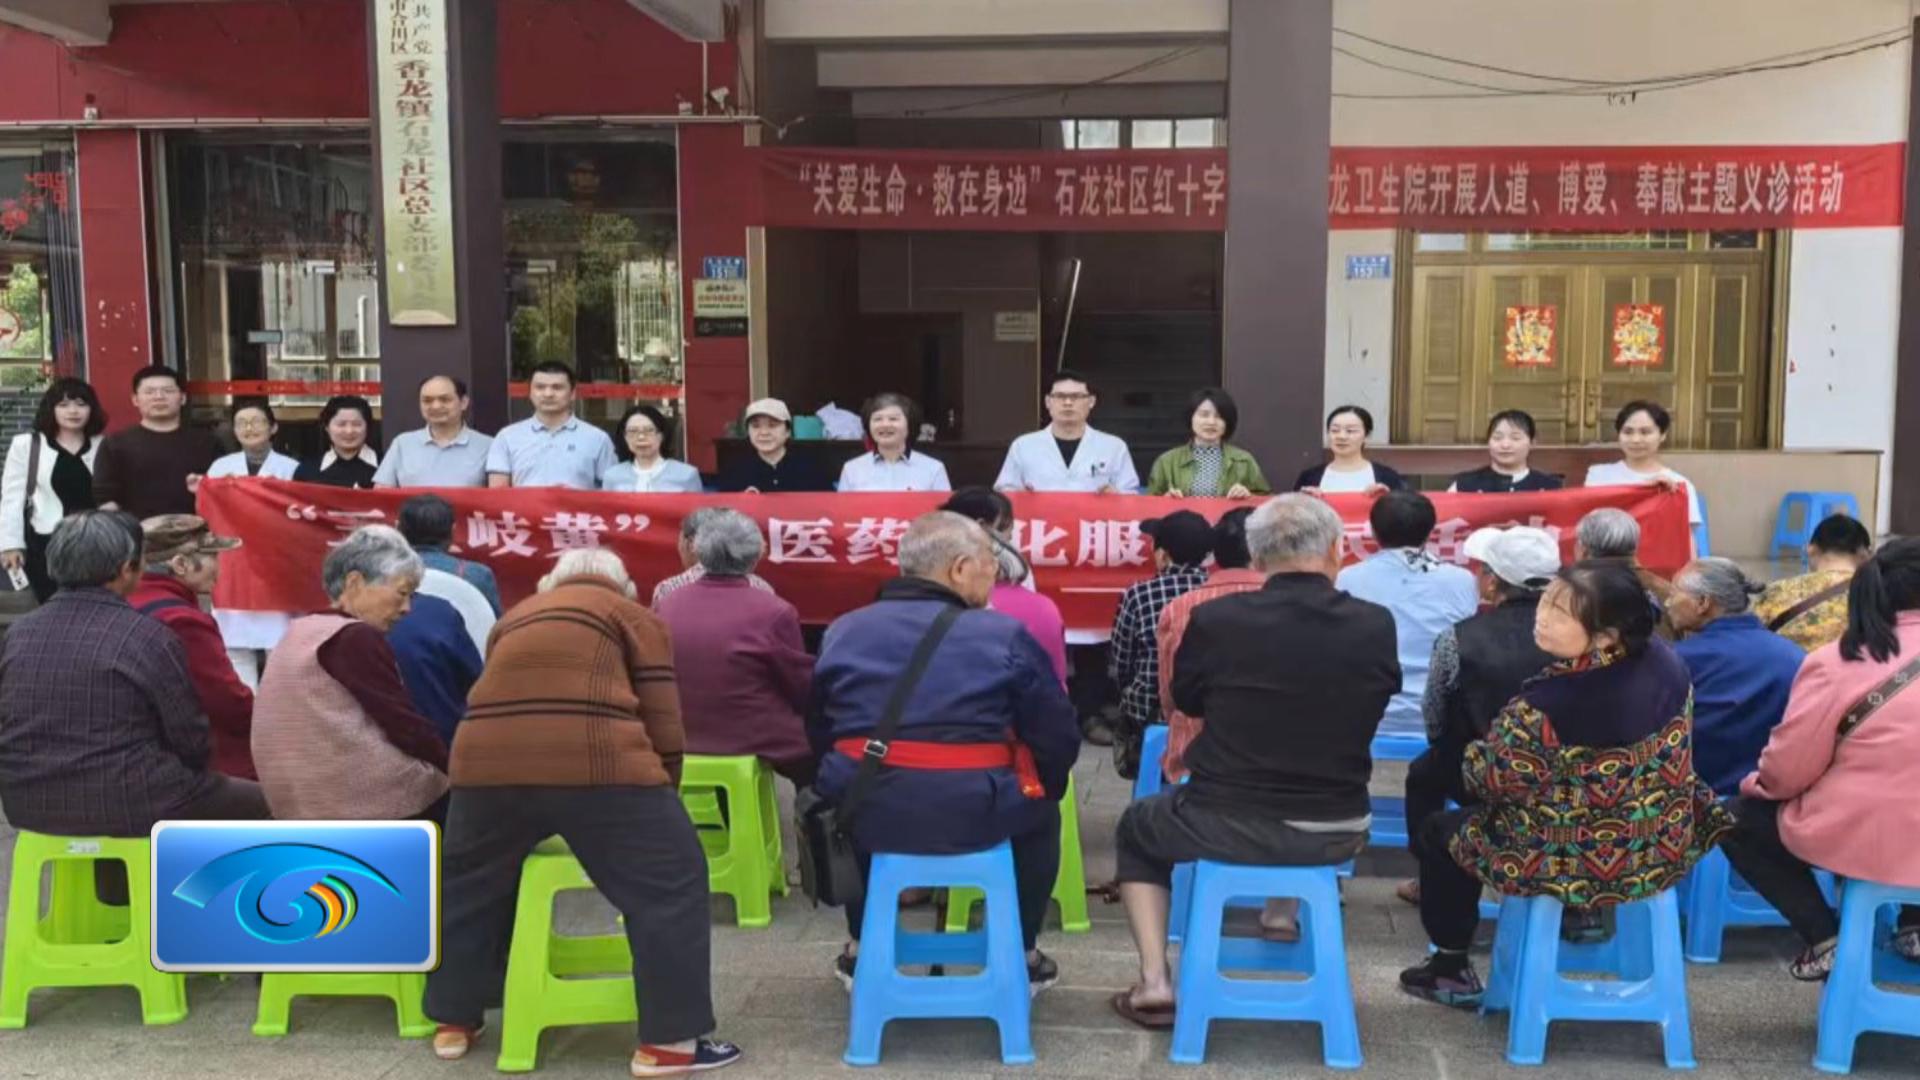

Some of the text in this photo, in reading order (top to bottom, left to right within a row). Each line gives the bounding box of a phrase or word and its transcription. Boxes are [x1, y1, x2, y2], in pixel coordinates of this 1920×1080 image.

[1054, 162, 1226, 217] 石龙社区红十字
[1328, 158, 1845, 217] 龙卫生院开展人道、博爱、奉献主题义诊活动
